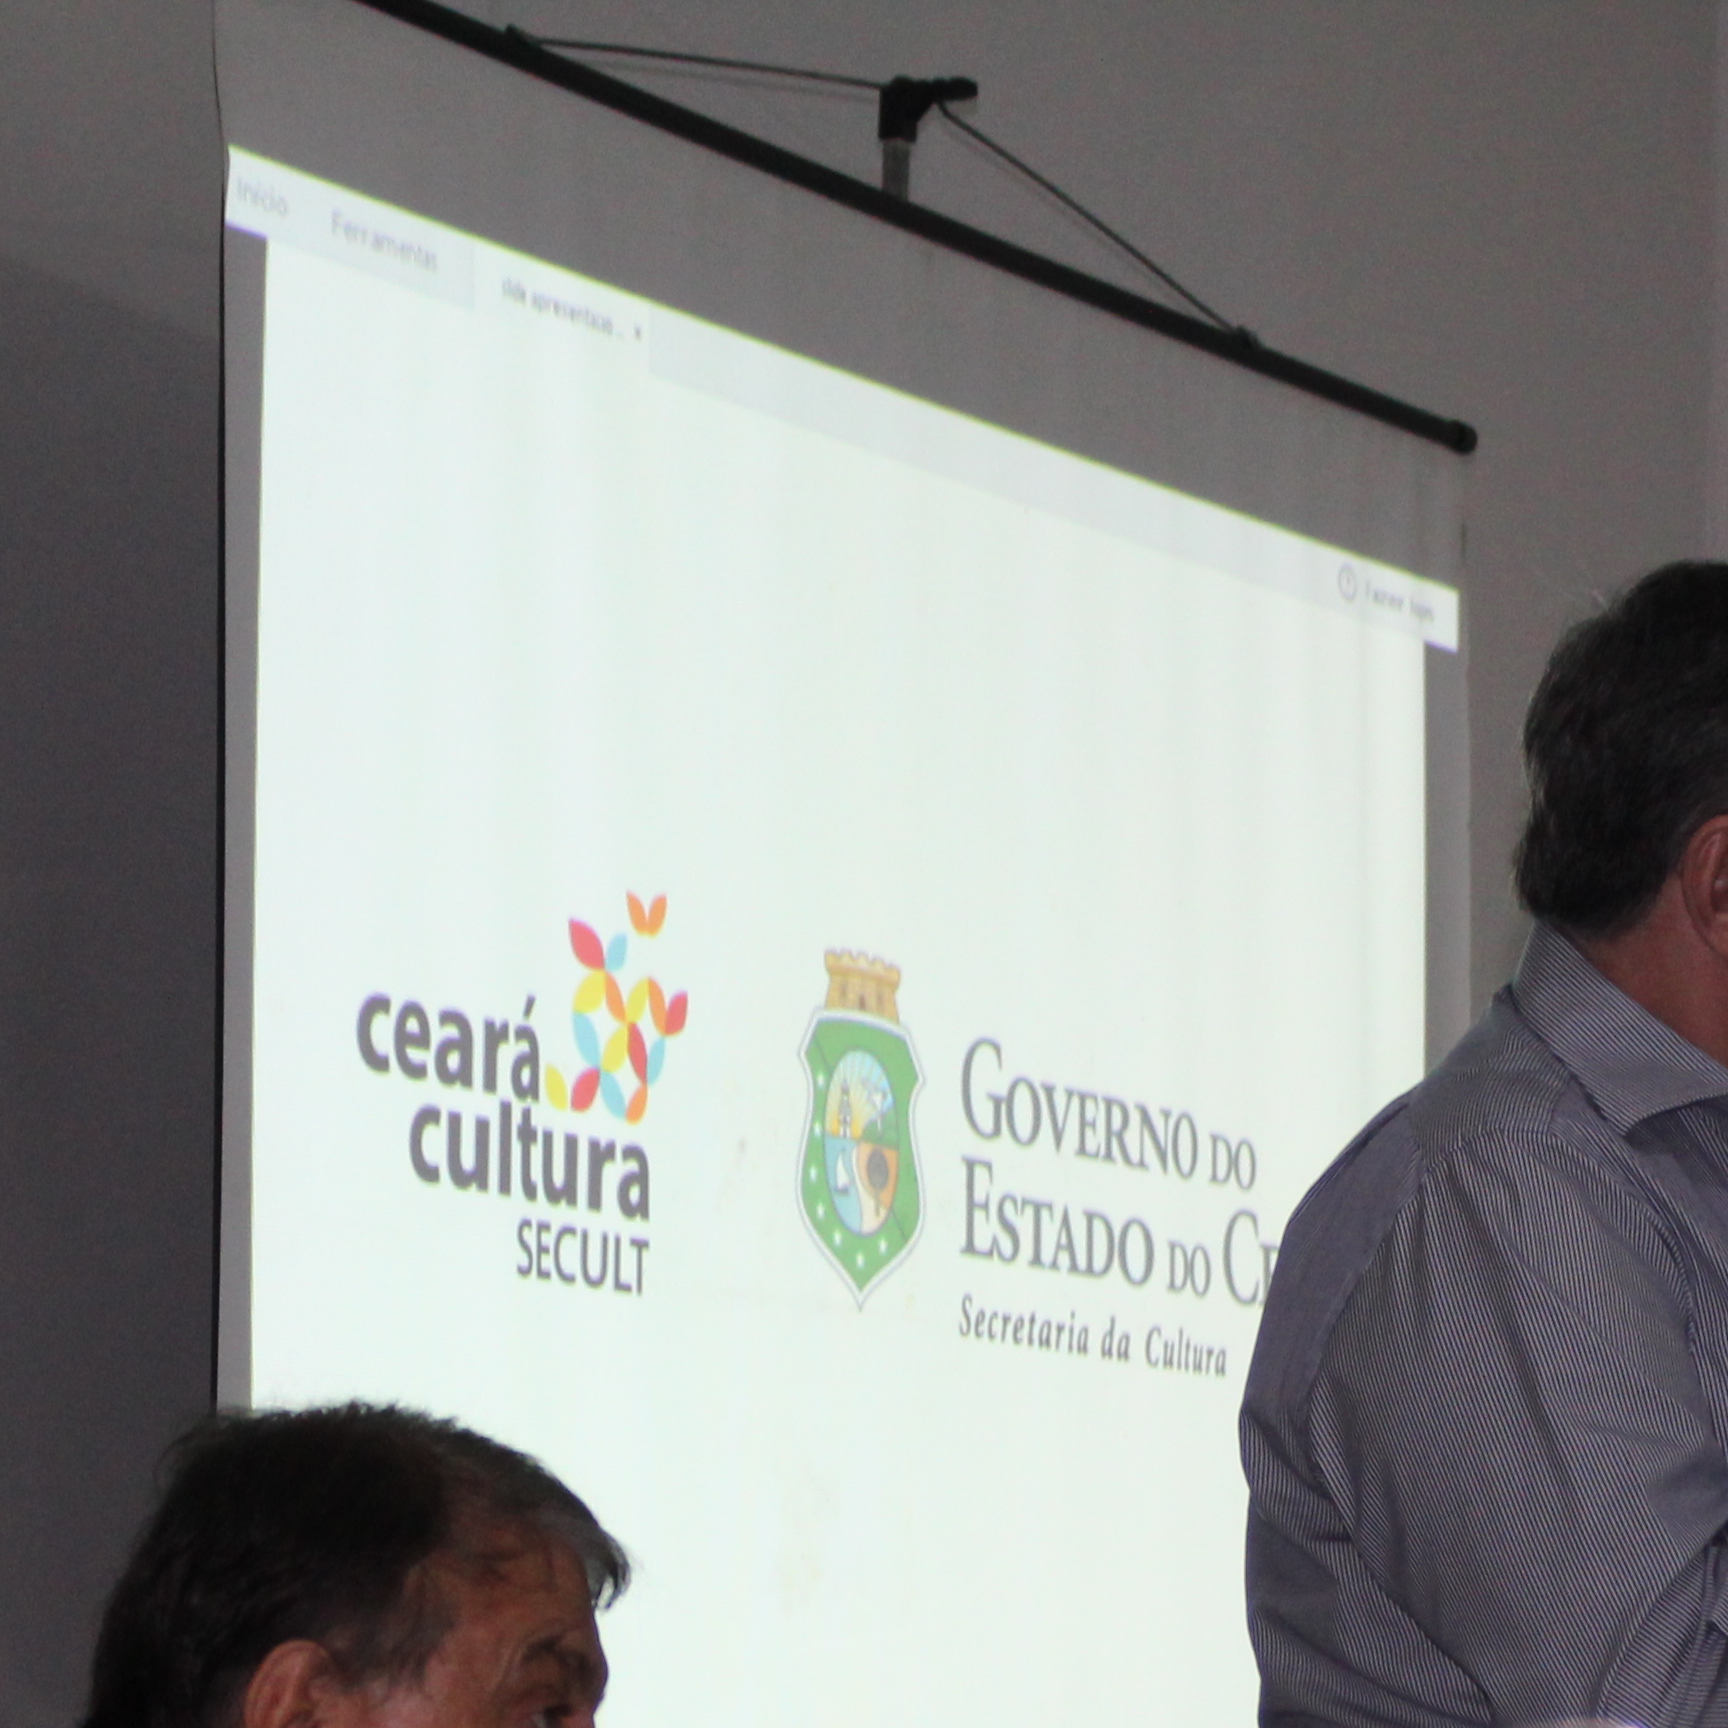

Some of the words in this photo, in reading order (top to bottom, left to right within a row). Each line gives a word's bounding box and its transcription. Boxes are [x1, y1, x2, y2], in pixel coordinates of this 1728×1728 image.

[356, 991, 541, 1104] ceará
[408, 1099, 651, 1222] cultura
[961, 1037, 1199, 1181] GOVERNO
[1209, 1133, 1257, 1191] DO
[516, 1217, 651, 1297] SECULT
[959, 1156, 1155, 1287] ESTADO
[1167, 1239, 1212, 1298] DO
[959, 1293, 1090, 1356] Secretaria
[1100, 1314, 1131, 1363] da
[1145, 1324, 1227, 1378] Cultura
